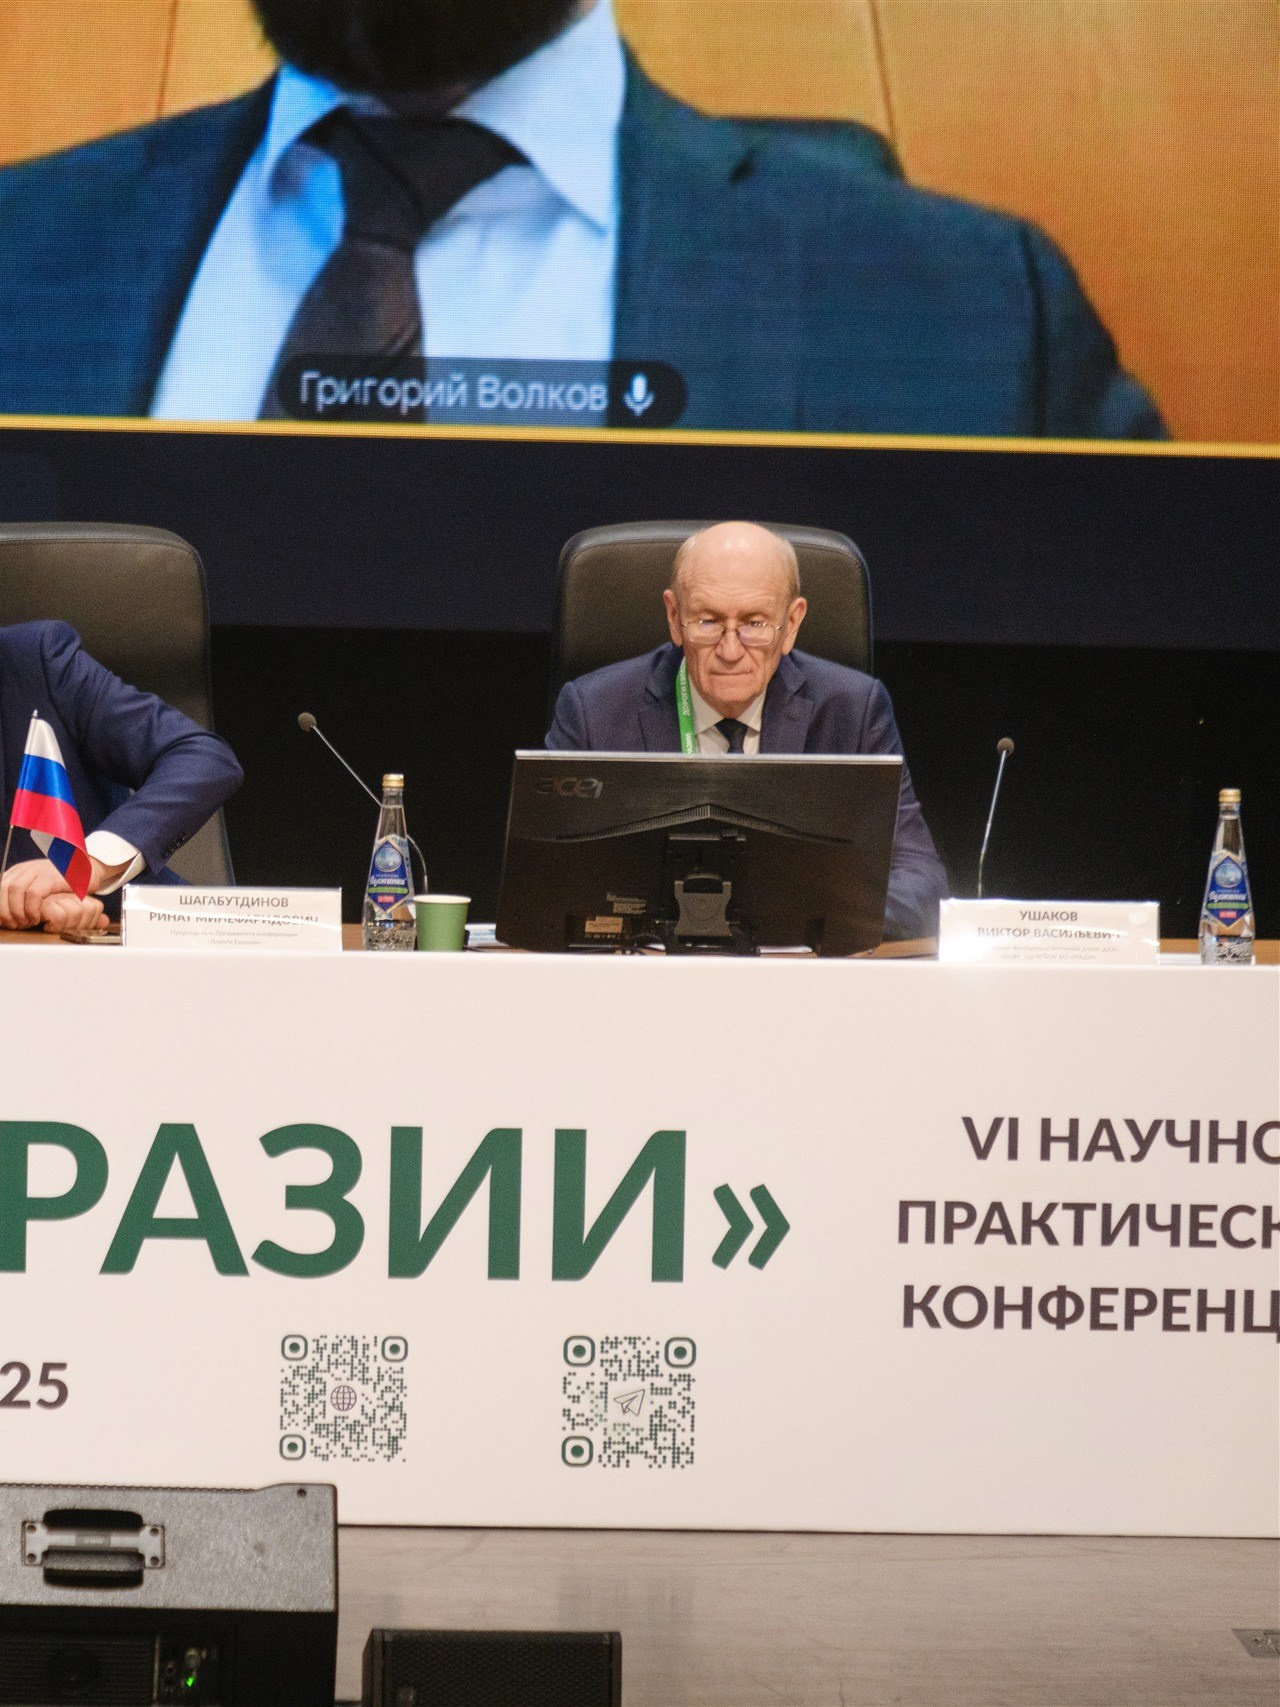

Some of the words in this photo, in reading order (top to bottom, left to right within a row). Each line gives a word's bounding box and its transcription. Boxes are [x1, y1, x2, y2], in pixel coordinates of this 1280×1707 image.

[300, 370, 468, 416] Григорий
[477, 374, 609, 411] Волков
[179, 895, 289, 908] ШАГАБУТДИНОВ
[1019, 910, 1078, 922] УШАКОВ
[977, 927, 1030, 938] ВИКТОР
[961, 1117, 1019, 1161] VI
[1040, 1117, 1280, 1165] НАУЧНО
[903, 1285, 1280, 1344] КОНФЕРЕНЦ
